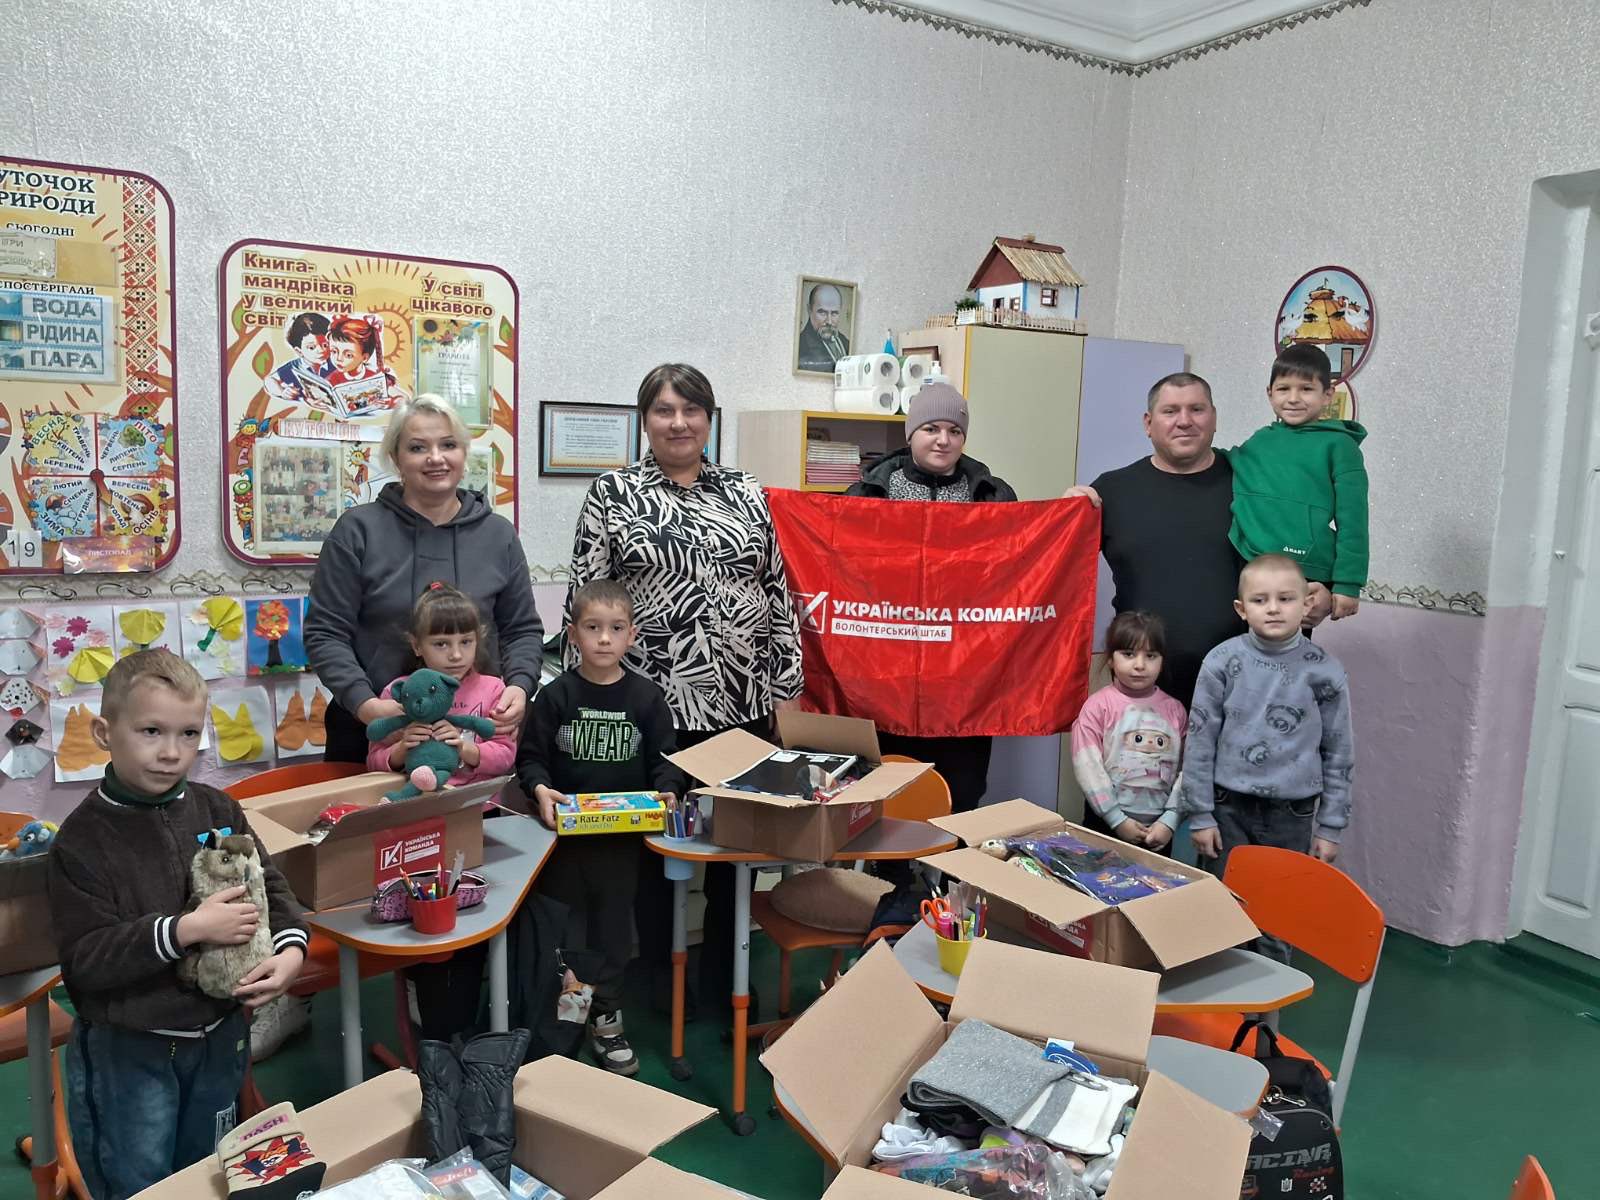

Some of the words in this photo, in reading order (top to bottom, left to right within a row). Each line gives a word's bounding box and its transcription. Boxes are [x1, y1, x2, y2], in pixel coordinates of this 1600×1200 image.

[0, 169, 95, 193] УТОЧОК
[0, 191, 95, 215] РИРОДИ
[6, 222, 75, 237] СЬОГОДНІ
[244, 253, 315, 273] Книга-
[244, 275, 355, 296] мандрівка
[441, 283, 482, 298] світі
[32, 298, 97, 318] ВОДА
[263, 295, 352, 313] великий
[412, 297, 493, 316] цікавого
[244, 311, 286, 326] світ
[27, 323, 100, 344] РІДИНА
[30, 350, 98, 369] ПАРА
[31, 415, 65, 445] ВЕСНА
[134, 421, 157, 443] ЛІТО
[56, 441, 85, 464] КВІТЕНЬ
[72, 426, 91, 459] ТРАВЕНЬ
[100, 430, 120, 460] ЧЕРВЕНЬ
[43, 459, 85, 472] БЕРЕЗЕНЬ
[109, 447, 138, 464] ЛИПЕНЬ
[112, 460, 147, 472] СЕРПЕНЬ
[53, 480, 83, 491] ЛЮТИЙ
[112, 480, 151, 492] ВЕРЕСЕНЬ
[63, 487, 88, 506] СІЧЕНЬ
[76, 491, 95, 522] ГРУДЕНЬ
[40, 512, 65, 536] ЗИМА
[109, 504, 127, 529] ТОПАД
[133, 509, 160, 534] ОСІНЬ
[832, 599, 953, 622] УКРАЇНСЬКА
[957, 604, 1057, 624] КОМАНДА
[834, 622, 919, 637] ВОЛОНТЕРСЬКИЙ
[920, 627, 947, 638] ШТАБ
[581, 710, 626, 720] WORLDWIDE
[571, 720, 634, 761] WEAR
